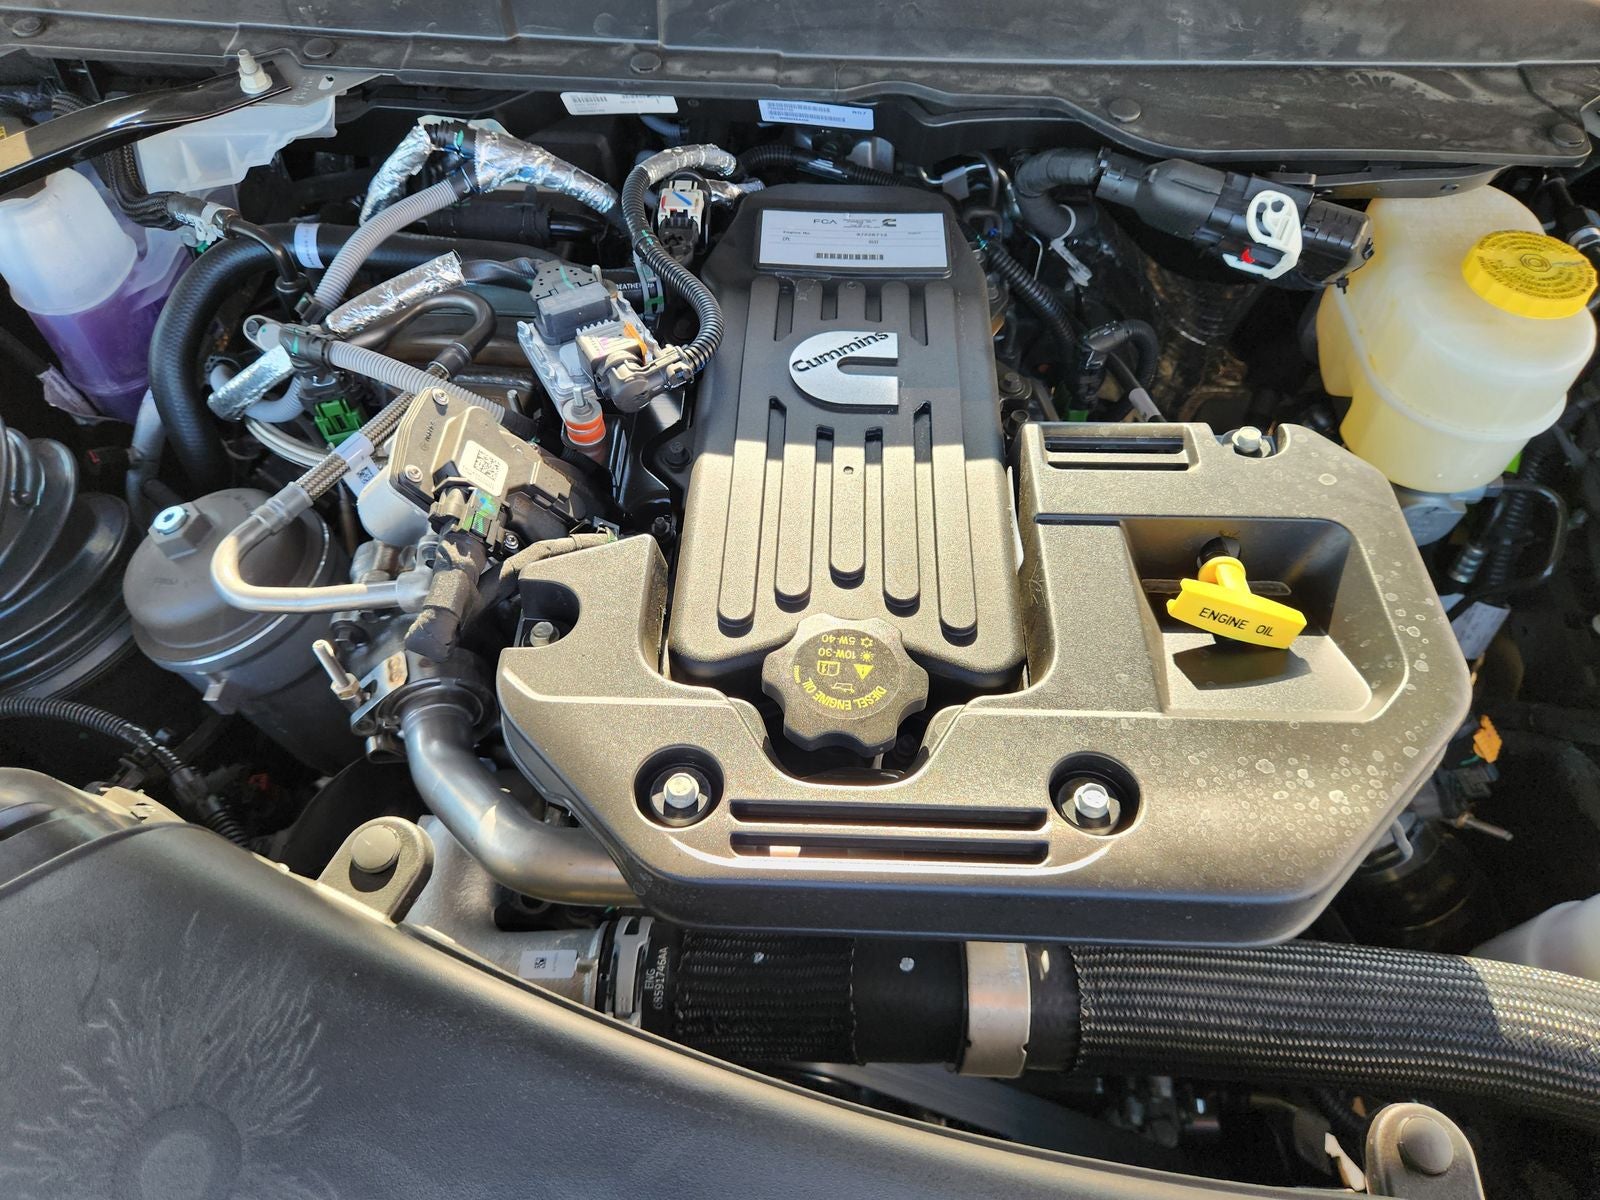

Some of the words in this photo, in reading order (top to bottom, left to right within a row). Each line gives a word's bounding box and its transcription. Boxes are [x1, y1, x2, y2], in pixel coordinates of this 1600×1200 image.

[791, 331, 889, 373] Cummins
[1199, 607, 1250, 630] ENGINE
[1255, 625, 1273, 637] OIL
[821, 634, 856, 646] 5W-40
[818, 648, 857, 660] 10W-30
[802, 677, 815, 693] OIL
[813, 691, 852, 710] ENGINE
[853, 686, 887, 708] DIESEL
[644, 967, 656, 990] ENG
